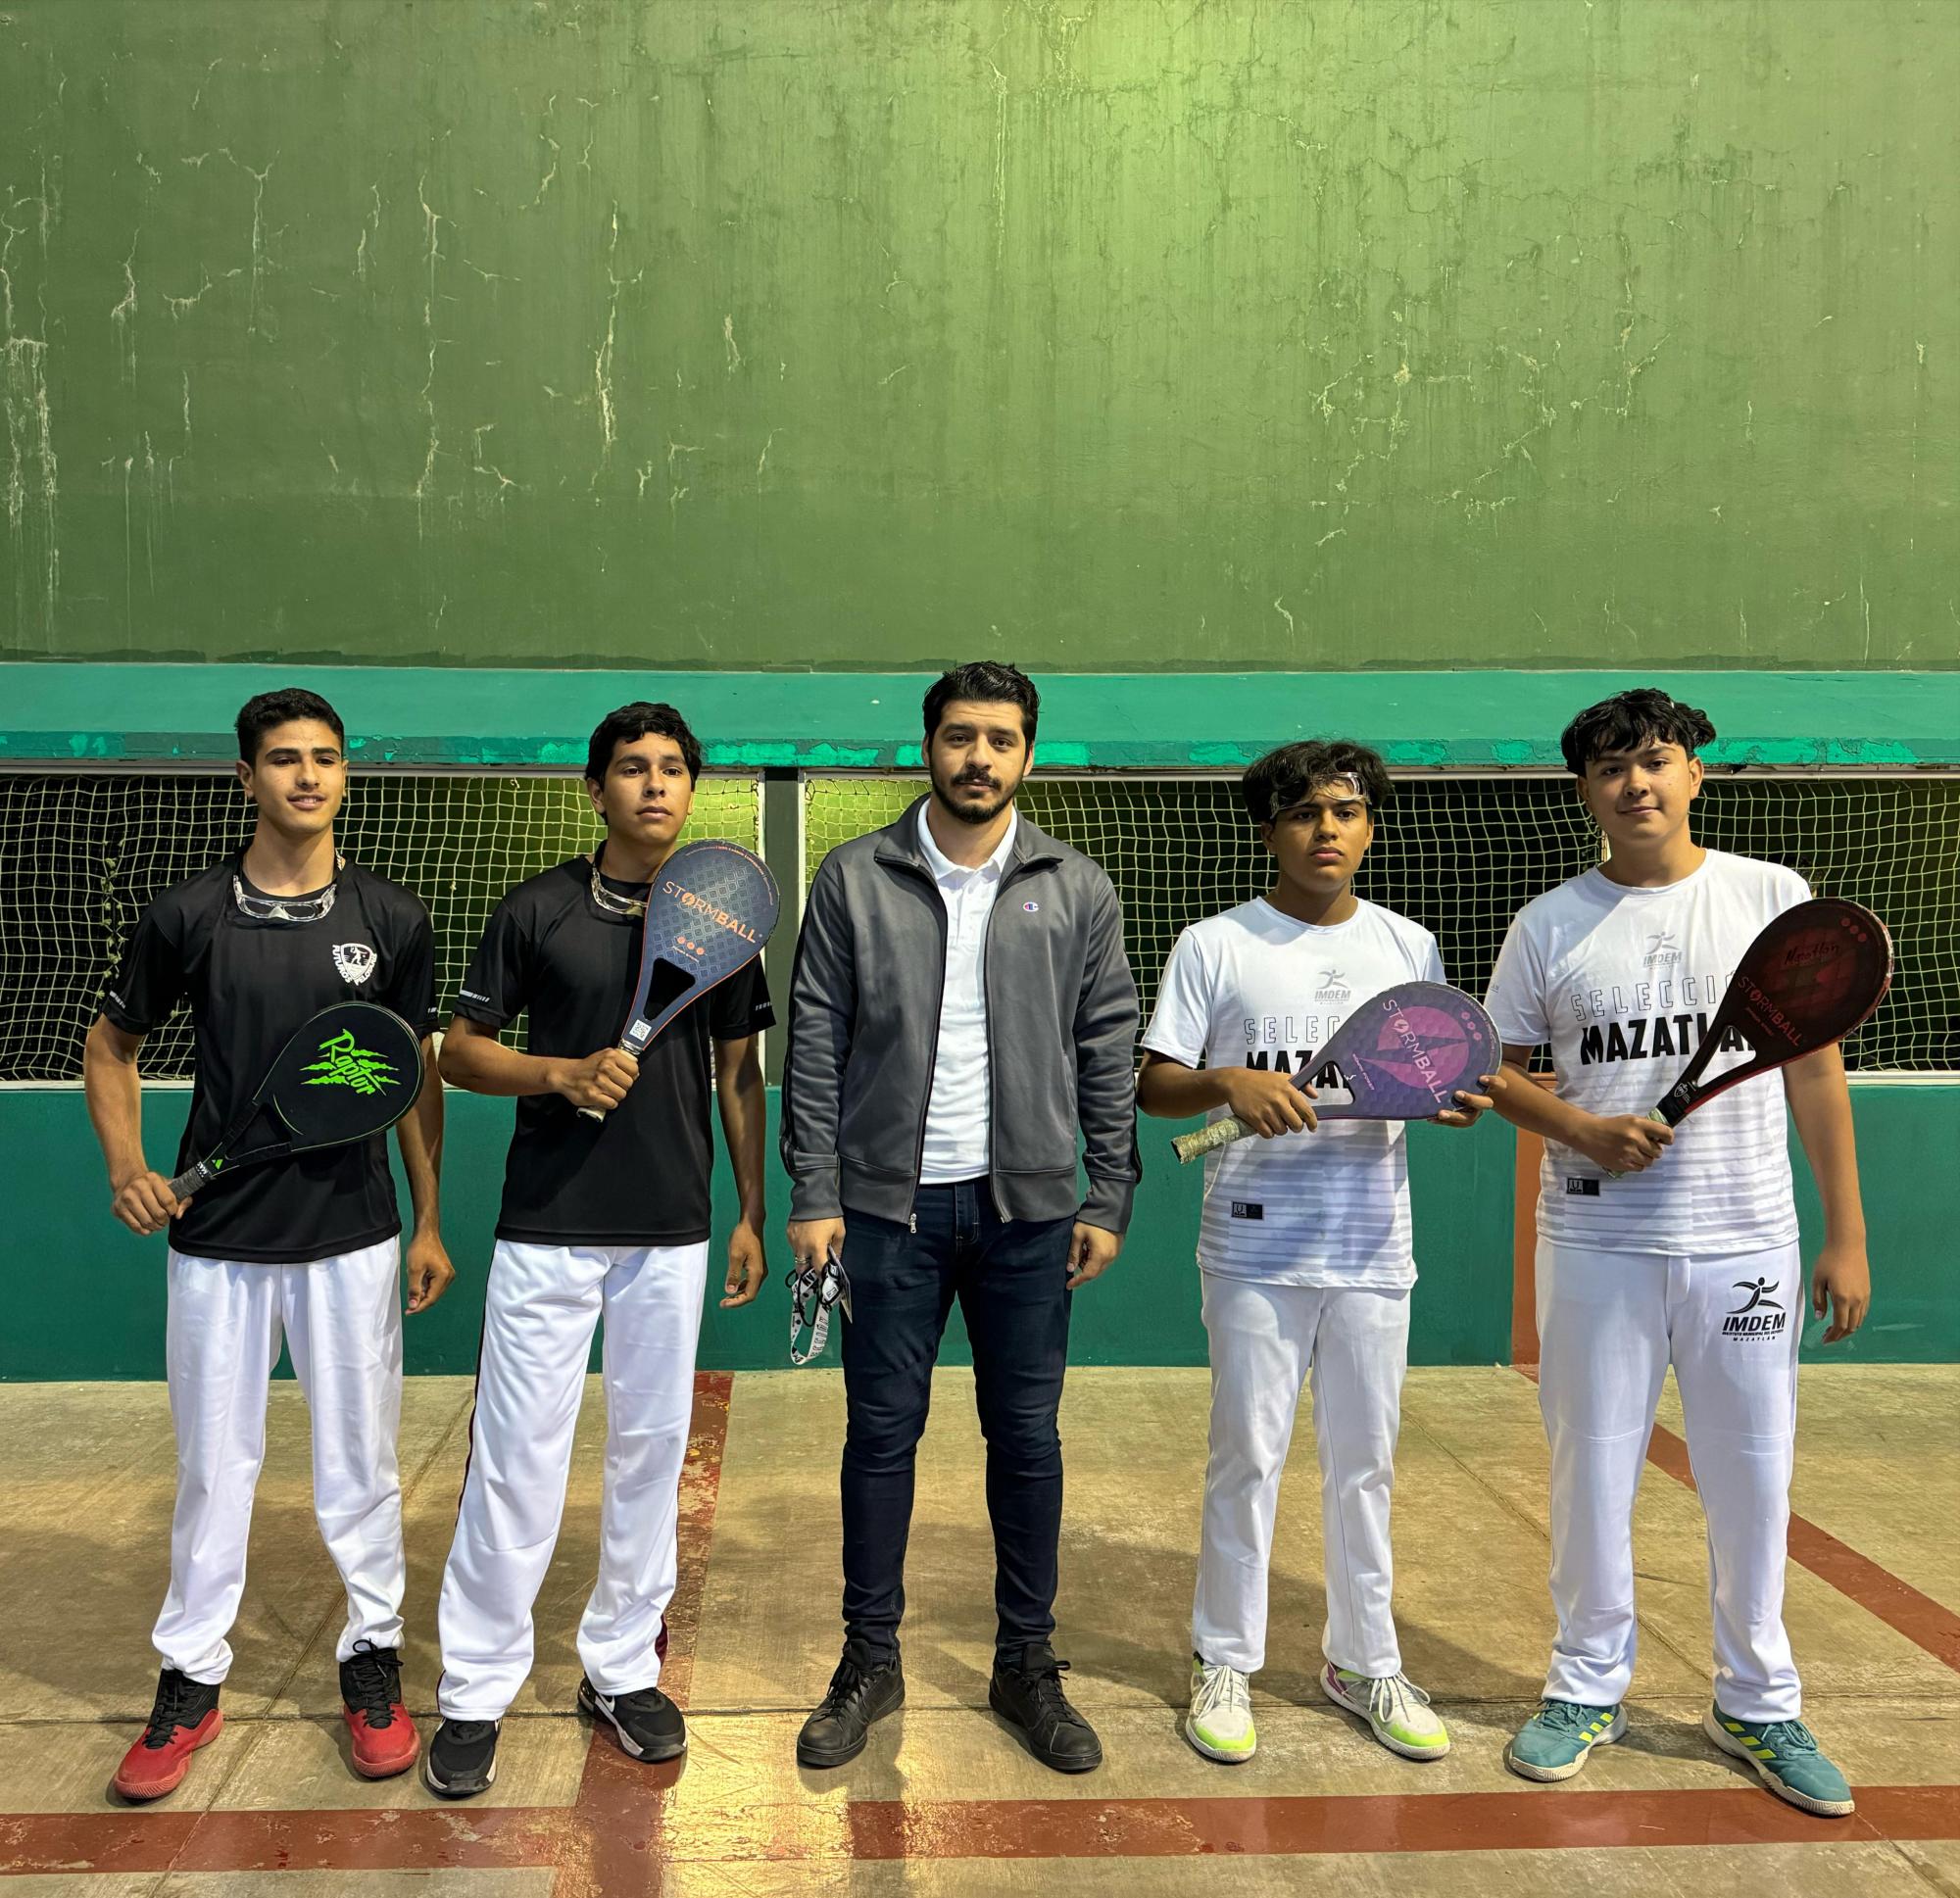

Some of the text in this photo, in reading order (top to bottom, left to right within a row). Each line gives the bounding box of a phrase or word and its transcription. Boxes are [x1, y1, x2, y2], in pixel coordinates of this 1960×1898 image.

[662, 880, 757, 944] STORMBALL
[1643, 951, 1683, 965] IMDEM
[1314, 990, 1351, 1000] IMDEM
[1738, 976, 1803, 1046] STORMBALL
[1383, 998, 1447, 1104] STORMBALL
[1580, 1012, 1754, 1065] MAZATA
[1723, 1312, 1787, 1332] IMDEM
